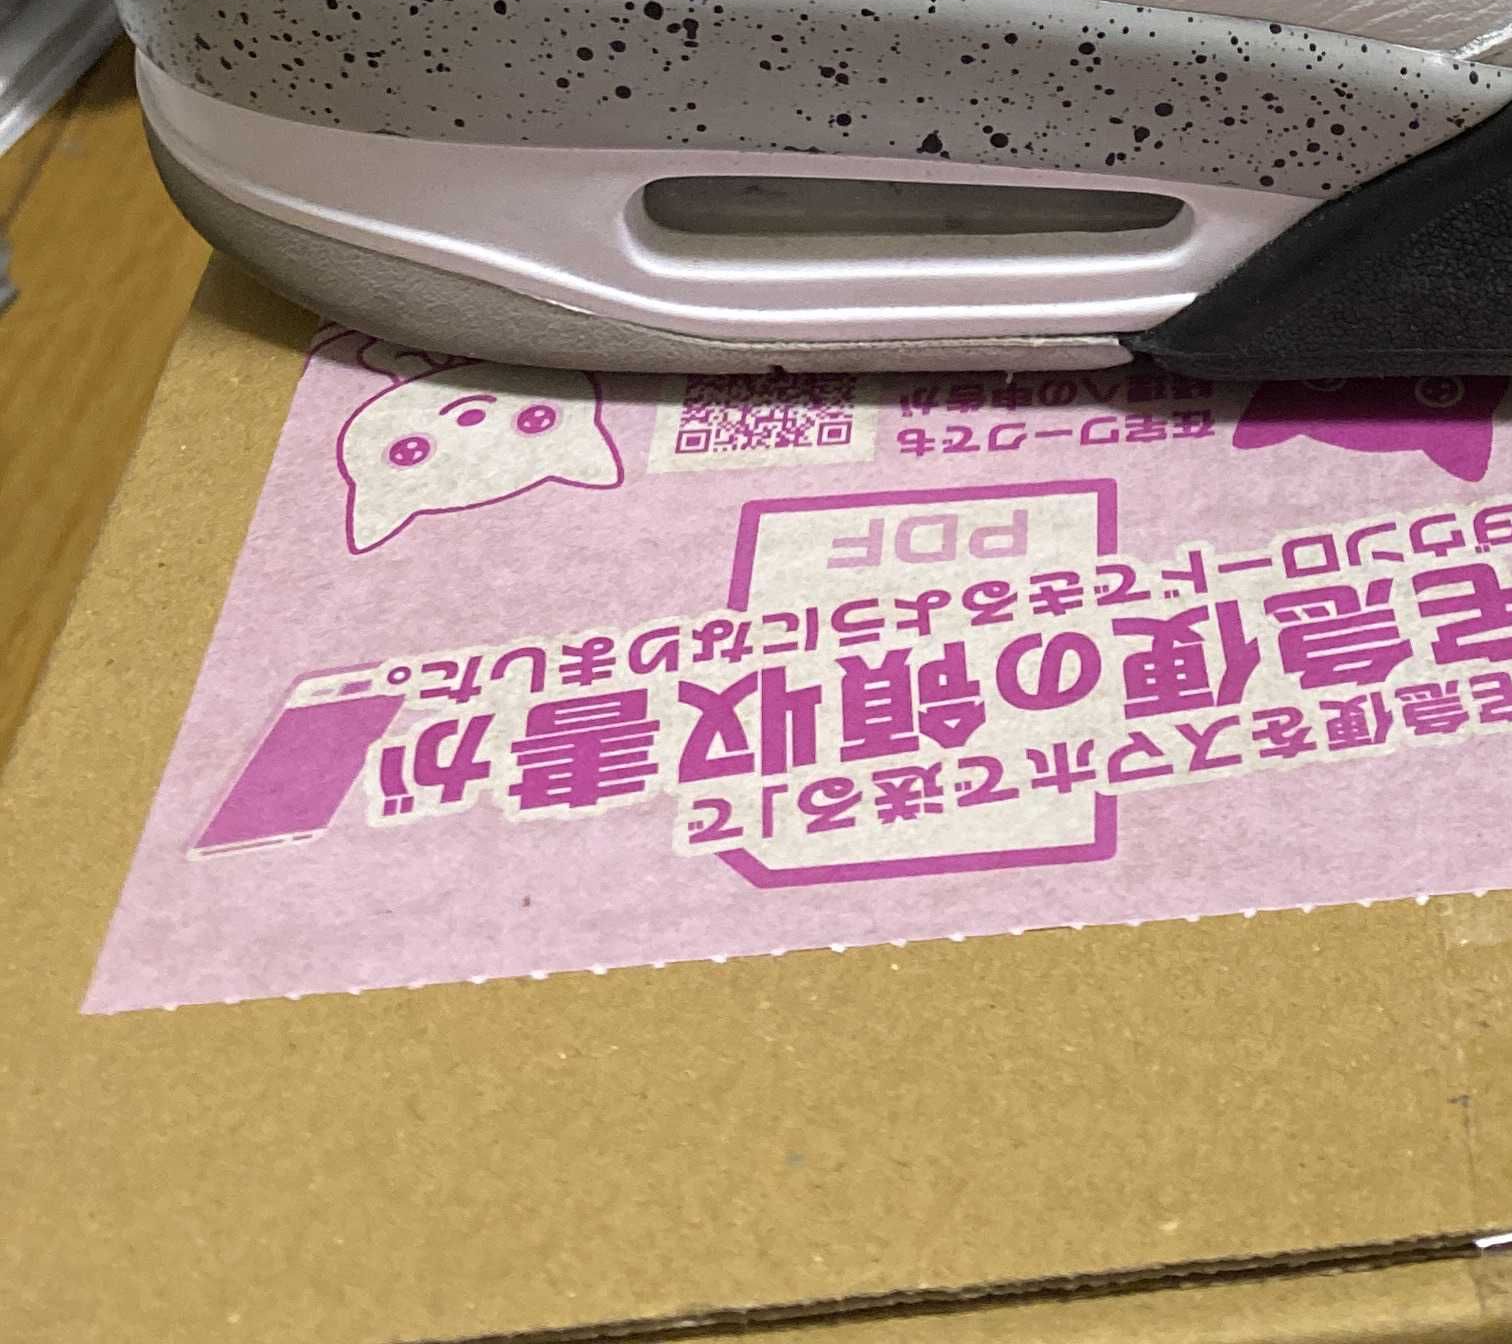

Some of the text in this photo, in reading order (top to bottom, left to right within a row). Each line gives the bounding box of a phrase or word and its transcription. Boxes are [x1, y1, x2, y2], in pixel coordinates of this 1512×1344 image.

[897, 410, 1216, 458] 在宅ワークでも
[827, 508, 1030, 569] PDF
